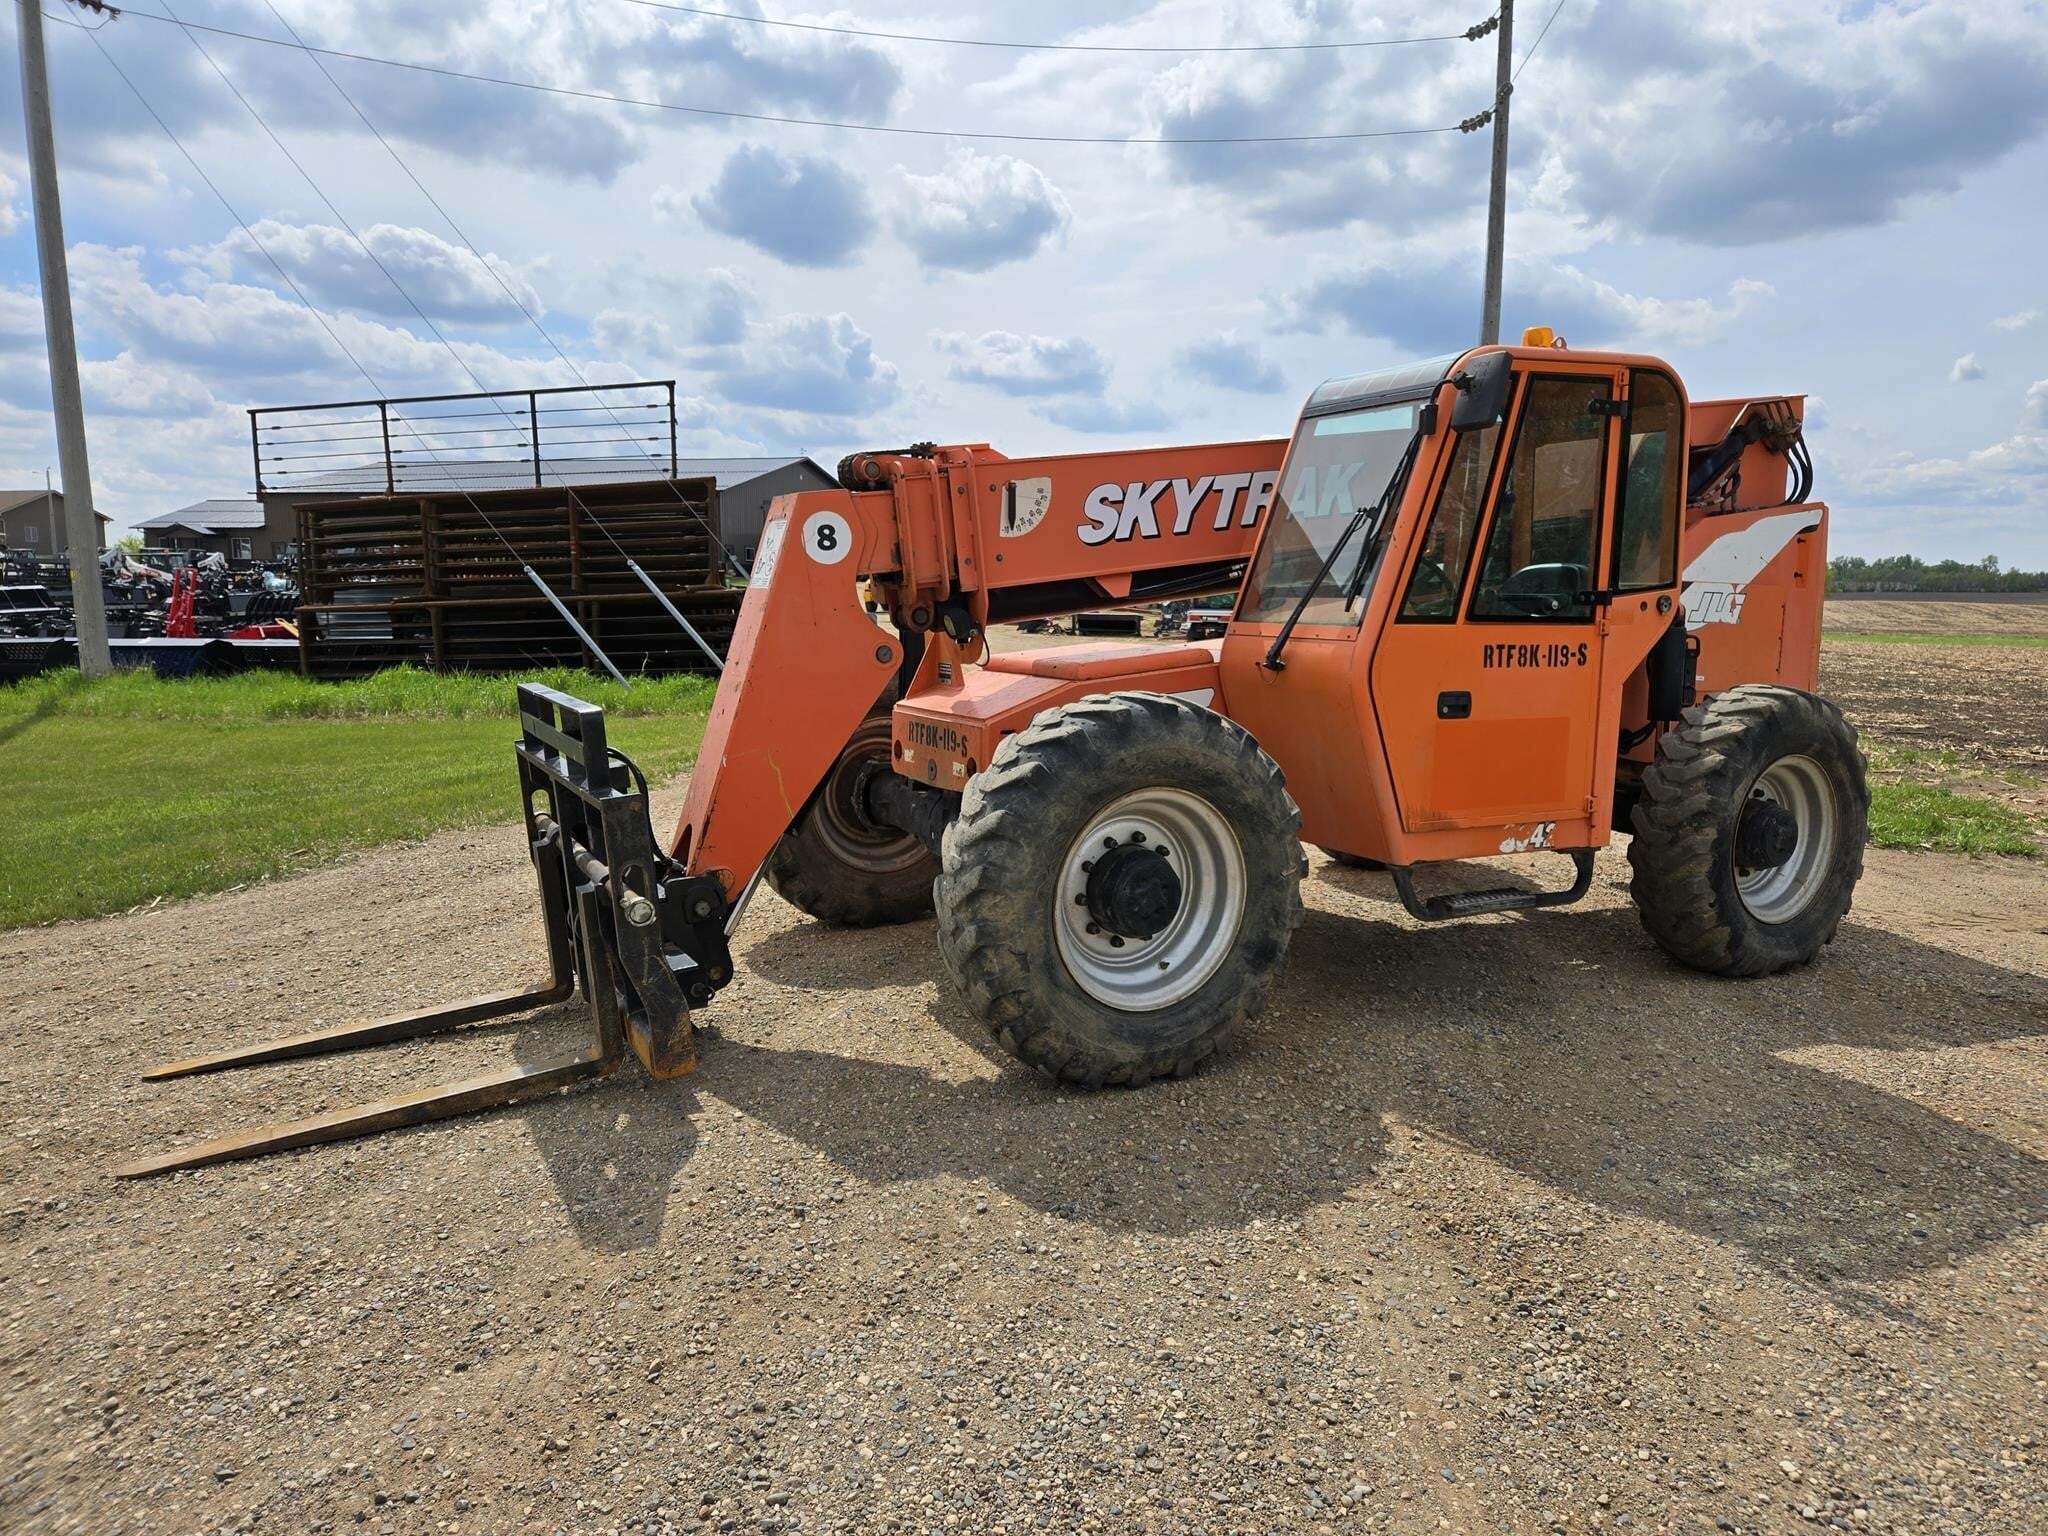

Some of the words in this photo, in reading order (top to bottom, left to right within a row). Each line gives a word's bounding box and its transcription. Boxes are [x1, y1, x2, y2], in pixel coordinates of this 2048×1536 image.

[1077, 462, 1367, 546] SKYTRAK
[816, 524, 837, 551] 8
[1687, 591, 1747, 625] JLG
[1483, 642, 1588, 669] RTF8K-119-S
[908, 720, 968, 758] RTF8K-119-S
